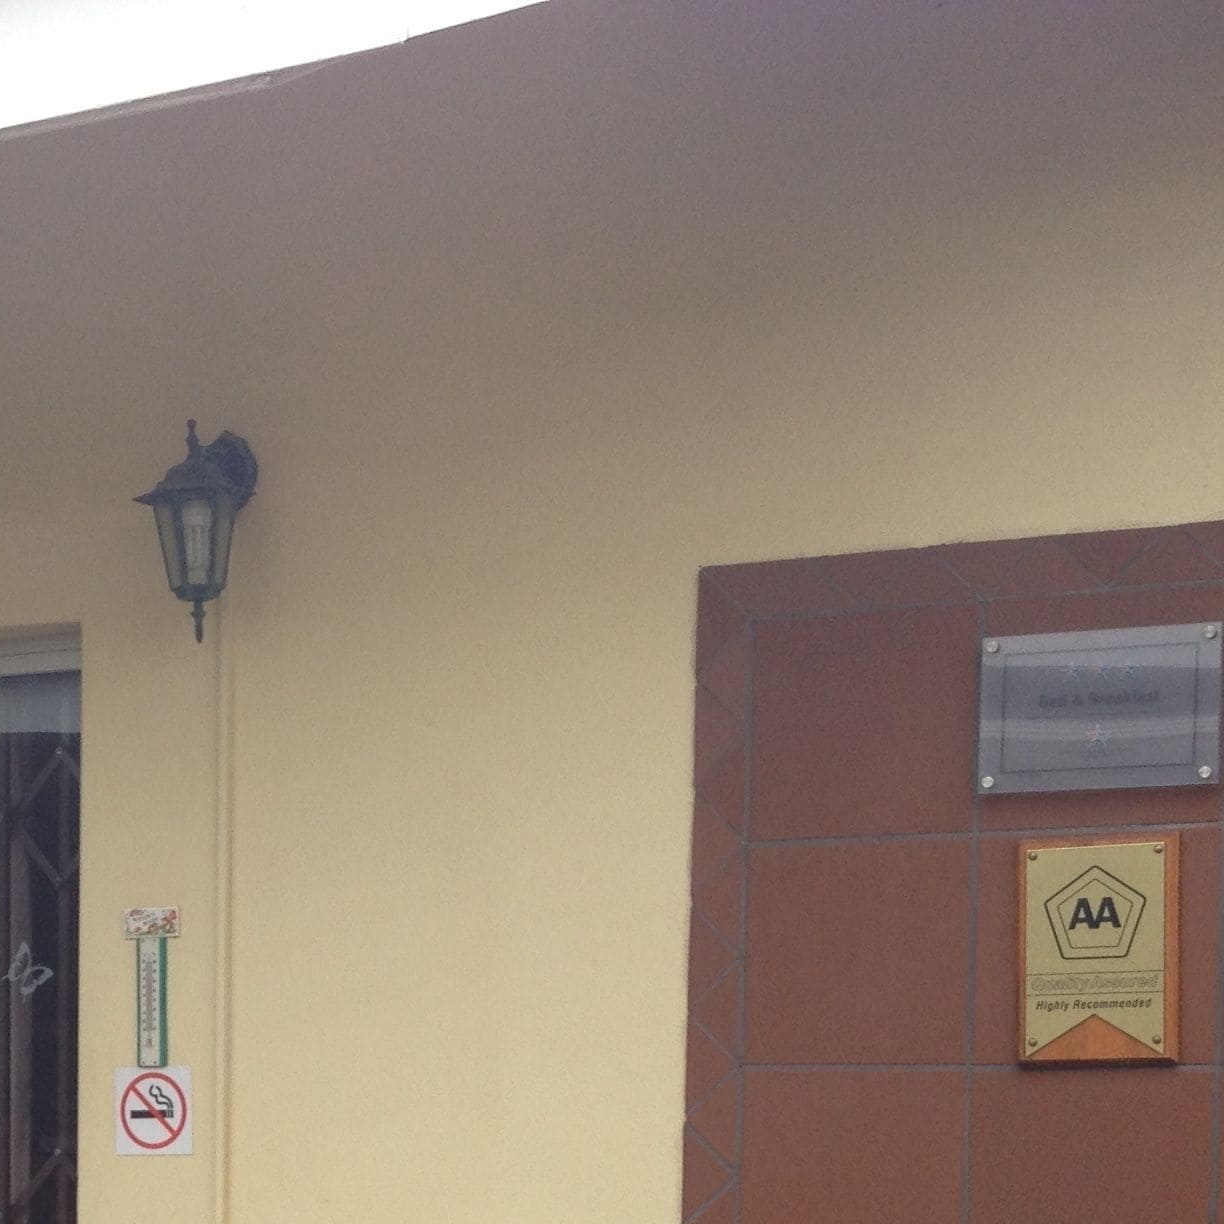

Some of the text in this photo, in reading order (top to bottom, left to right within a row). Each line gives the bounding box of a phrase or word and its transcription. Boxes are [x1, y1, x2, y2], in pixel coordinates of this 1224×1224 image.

[1068, 896, 1122, 930] AA
[1036, 998, 1152, 1013] Highly Recommended
